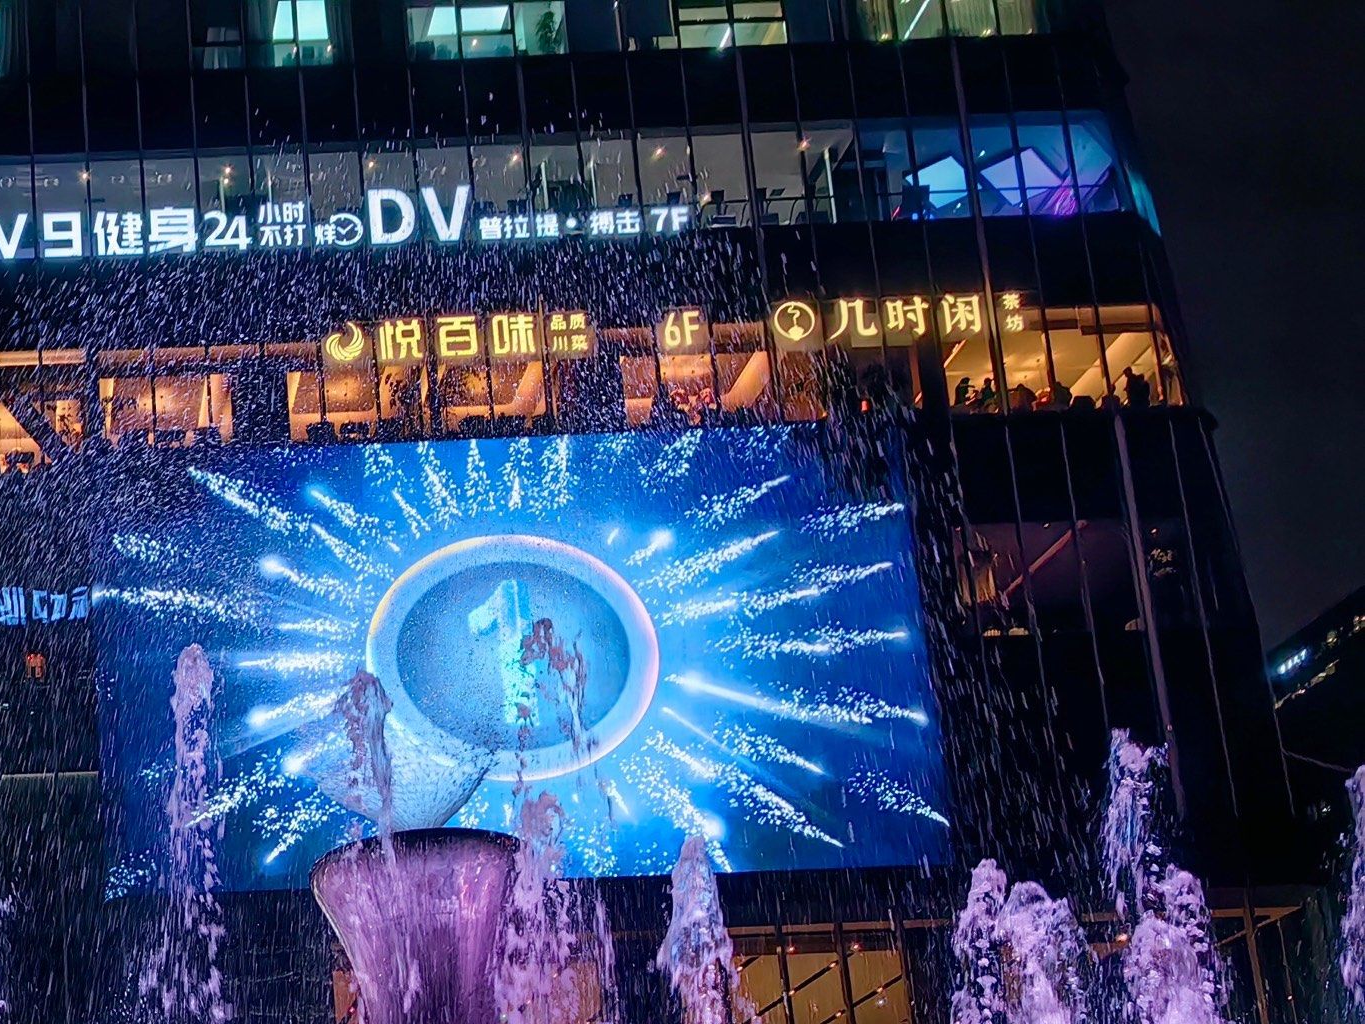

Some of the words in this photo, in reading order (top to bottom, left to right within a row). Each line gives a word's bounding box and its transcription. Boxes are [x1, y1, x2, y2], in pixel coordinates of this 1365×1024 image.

[367, 186, 472, 245] DV
[650, 207, 689, 233] 7F
[550, 312, 586, 331] 品质
[664, 311, 700, 347] 6F
[830, 294, 982, 340] 几时闲
[1002, 293, 1025, 332] 茶坊
[379, 314, 537, 360] 悦百味
